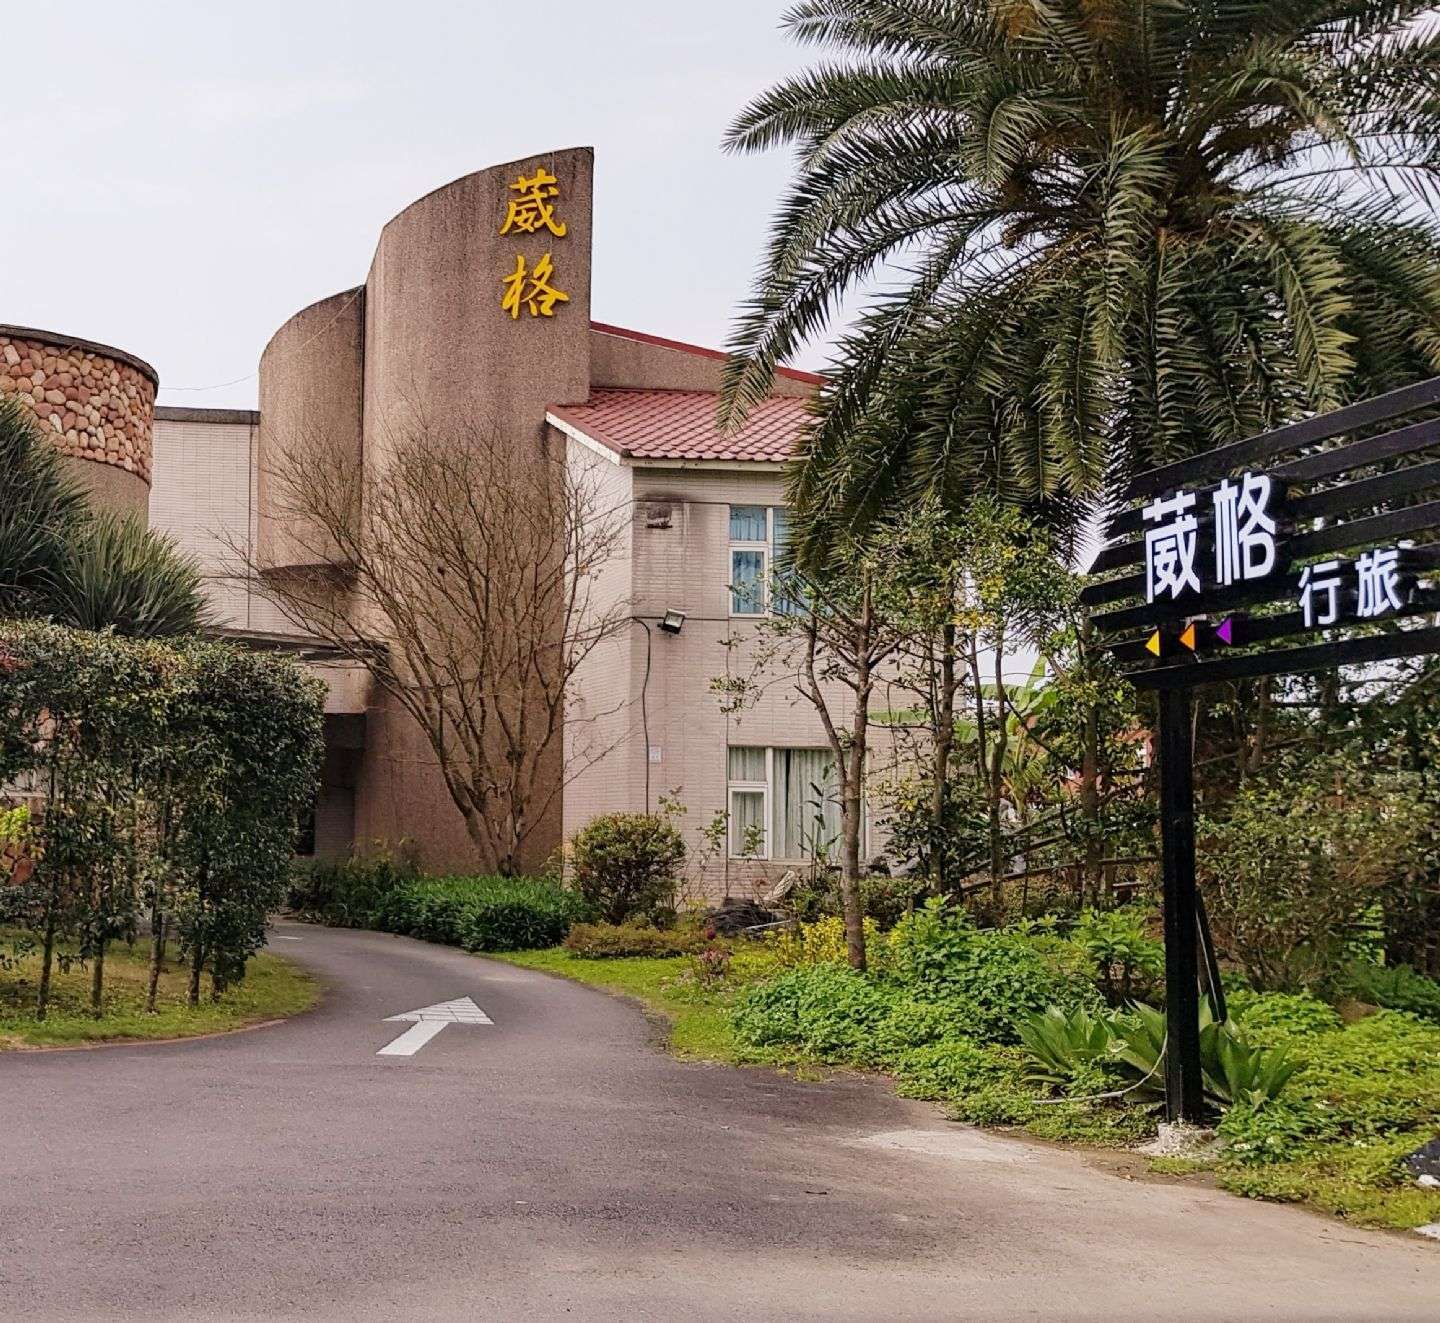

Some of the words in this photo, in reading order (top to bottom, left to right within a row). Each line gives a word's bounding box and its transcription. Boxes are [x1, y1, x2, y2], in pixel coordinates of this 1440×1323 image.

[500, 168, 569, 319] 葳格
[1143, 471, 1276, 603] 葳格
[1298, 549, 1402, 627] 行旅
